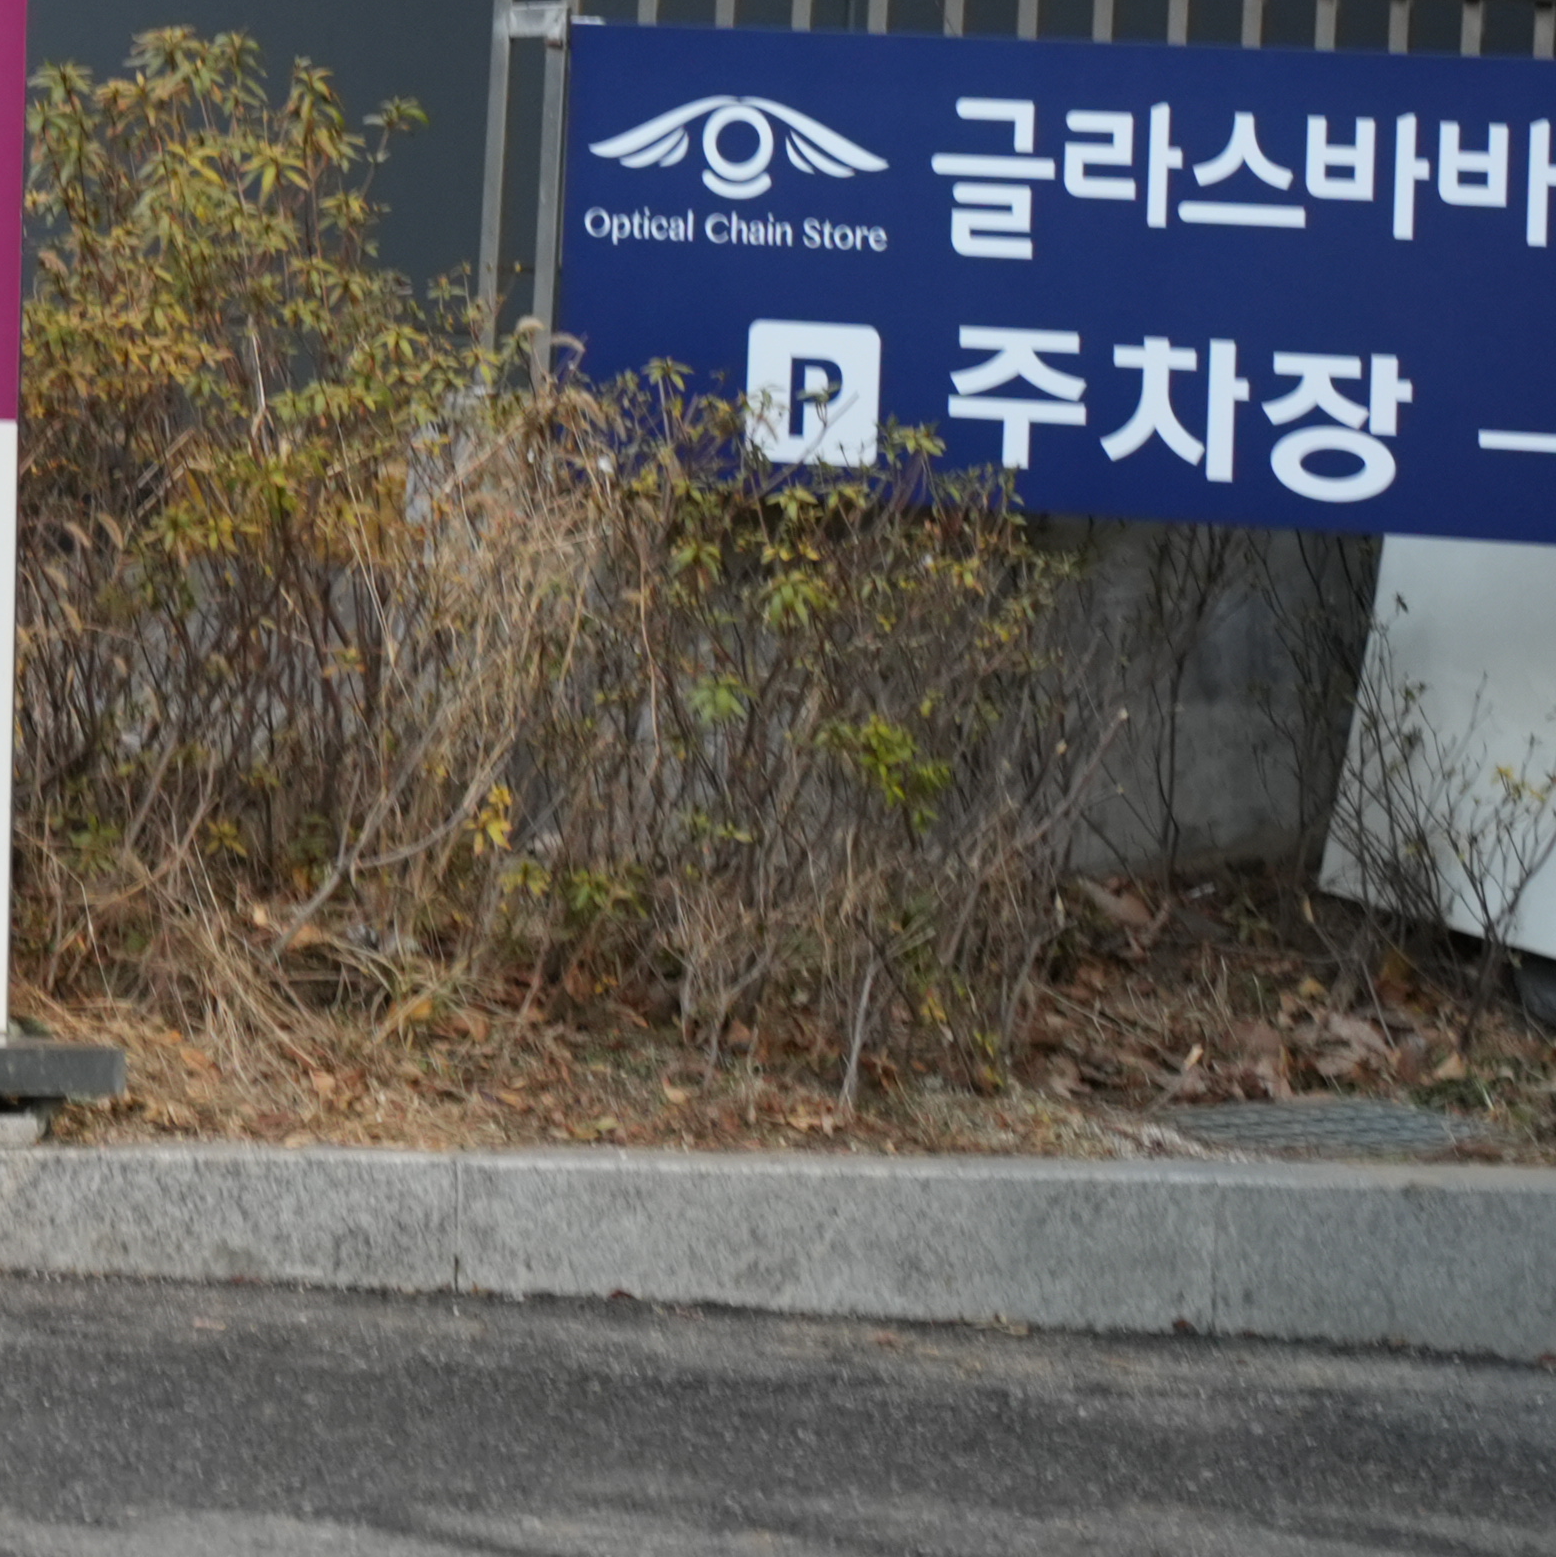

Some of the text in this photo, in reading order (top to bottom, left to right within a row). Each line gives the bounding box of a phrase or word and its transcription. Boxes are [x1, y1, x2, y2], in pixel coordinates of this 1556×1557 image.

[584, 206, 888, 252] Optical Chain Store
[788, 356, 843, 440] P
[948, 325, 1413, 502] 주차장
